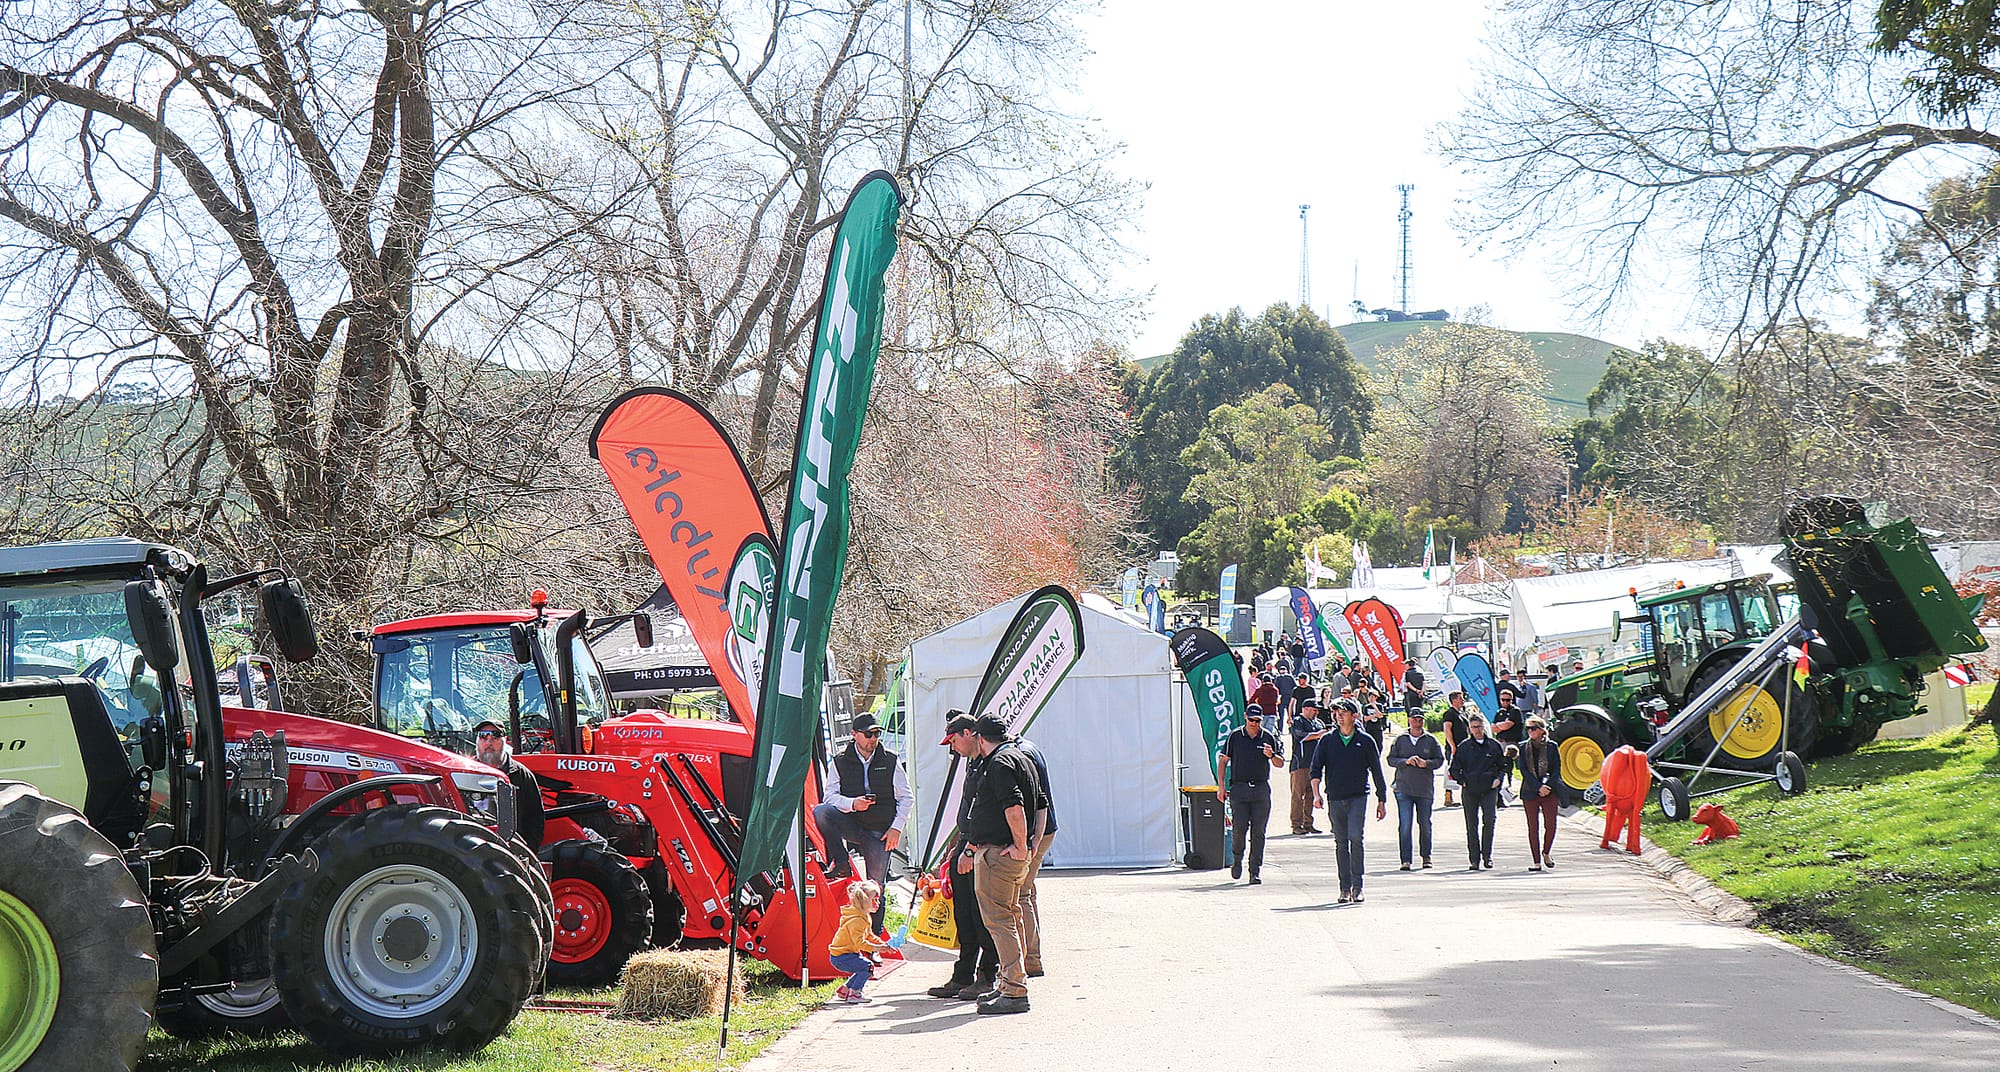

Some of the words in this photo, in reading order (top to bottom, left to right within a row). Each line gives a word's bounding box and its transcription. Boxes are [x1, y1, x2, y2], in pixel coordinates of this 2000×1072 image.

[1372, 627, 1400, 663] Bobcat
[634, 671, 652, 680] PH:
[653, 670, 666, 679] 03
[668, 669, 692, 678] 5979
[694, 667, 715, 677] 334
[998, 628, 1061, 719] CHAPMAN
[1004, 679, 1040, 732] MACHINERY
[1038, 641, 1066, 680] SERVICE
[1472, 673, 1491, 697] TES
[613, 726, 663, 739] Kubota
[345, 754, 362, 768] S
[365, 760, 392, 770] 5711
[557, 759, 616, 773] KUBOTA
